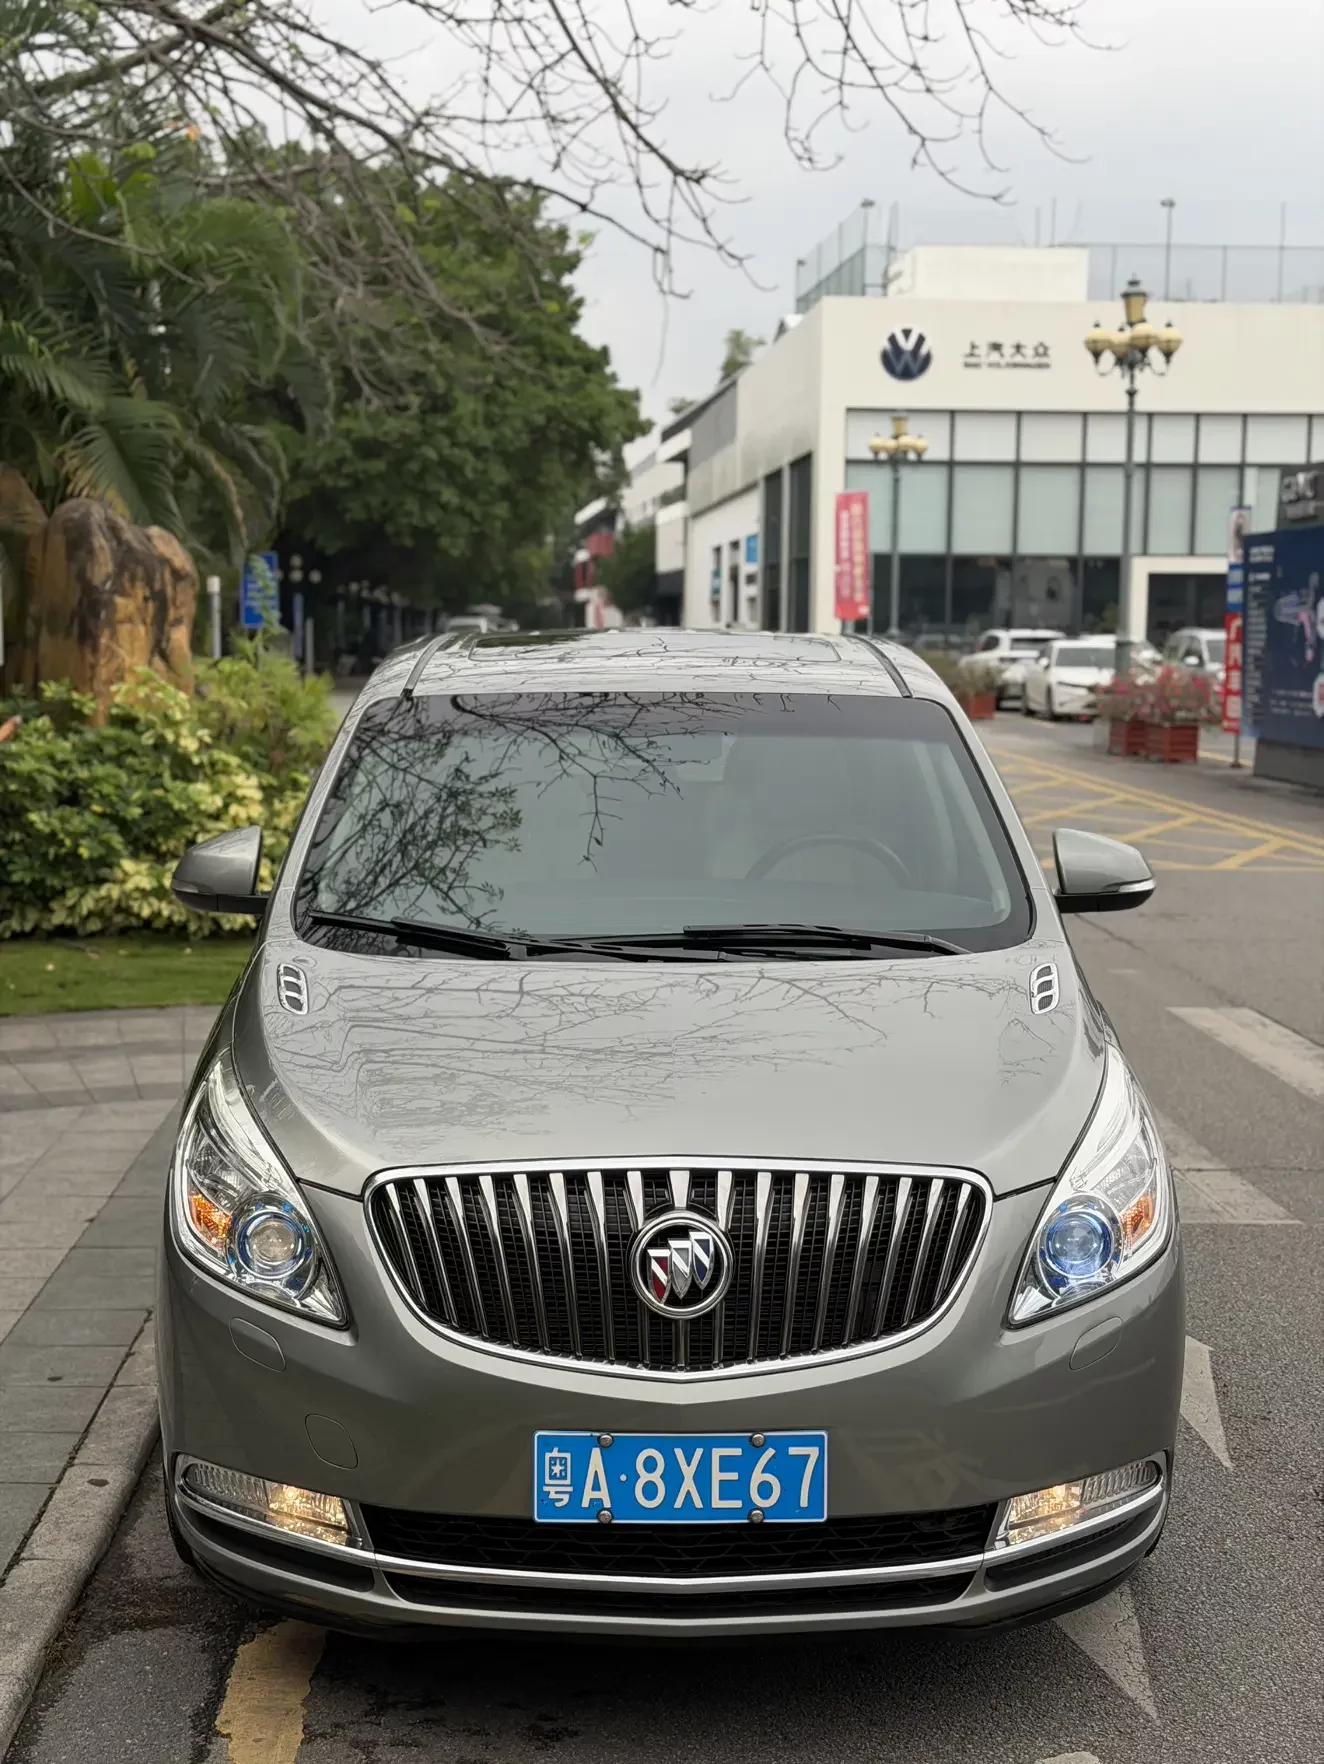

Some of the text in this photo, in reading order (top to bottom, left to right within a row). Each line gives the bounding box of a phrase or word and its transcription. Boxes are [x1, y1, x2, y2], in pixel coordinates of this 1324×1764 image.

[963, 341, 1050, 358] 上汽大众
[543, 1446, 820, 1509] 粤A·8XE67
